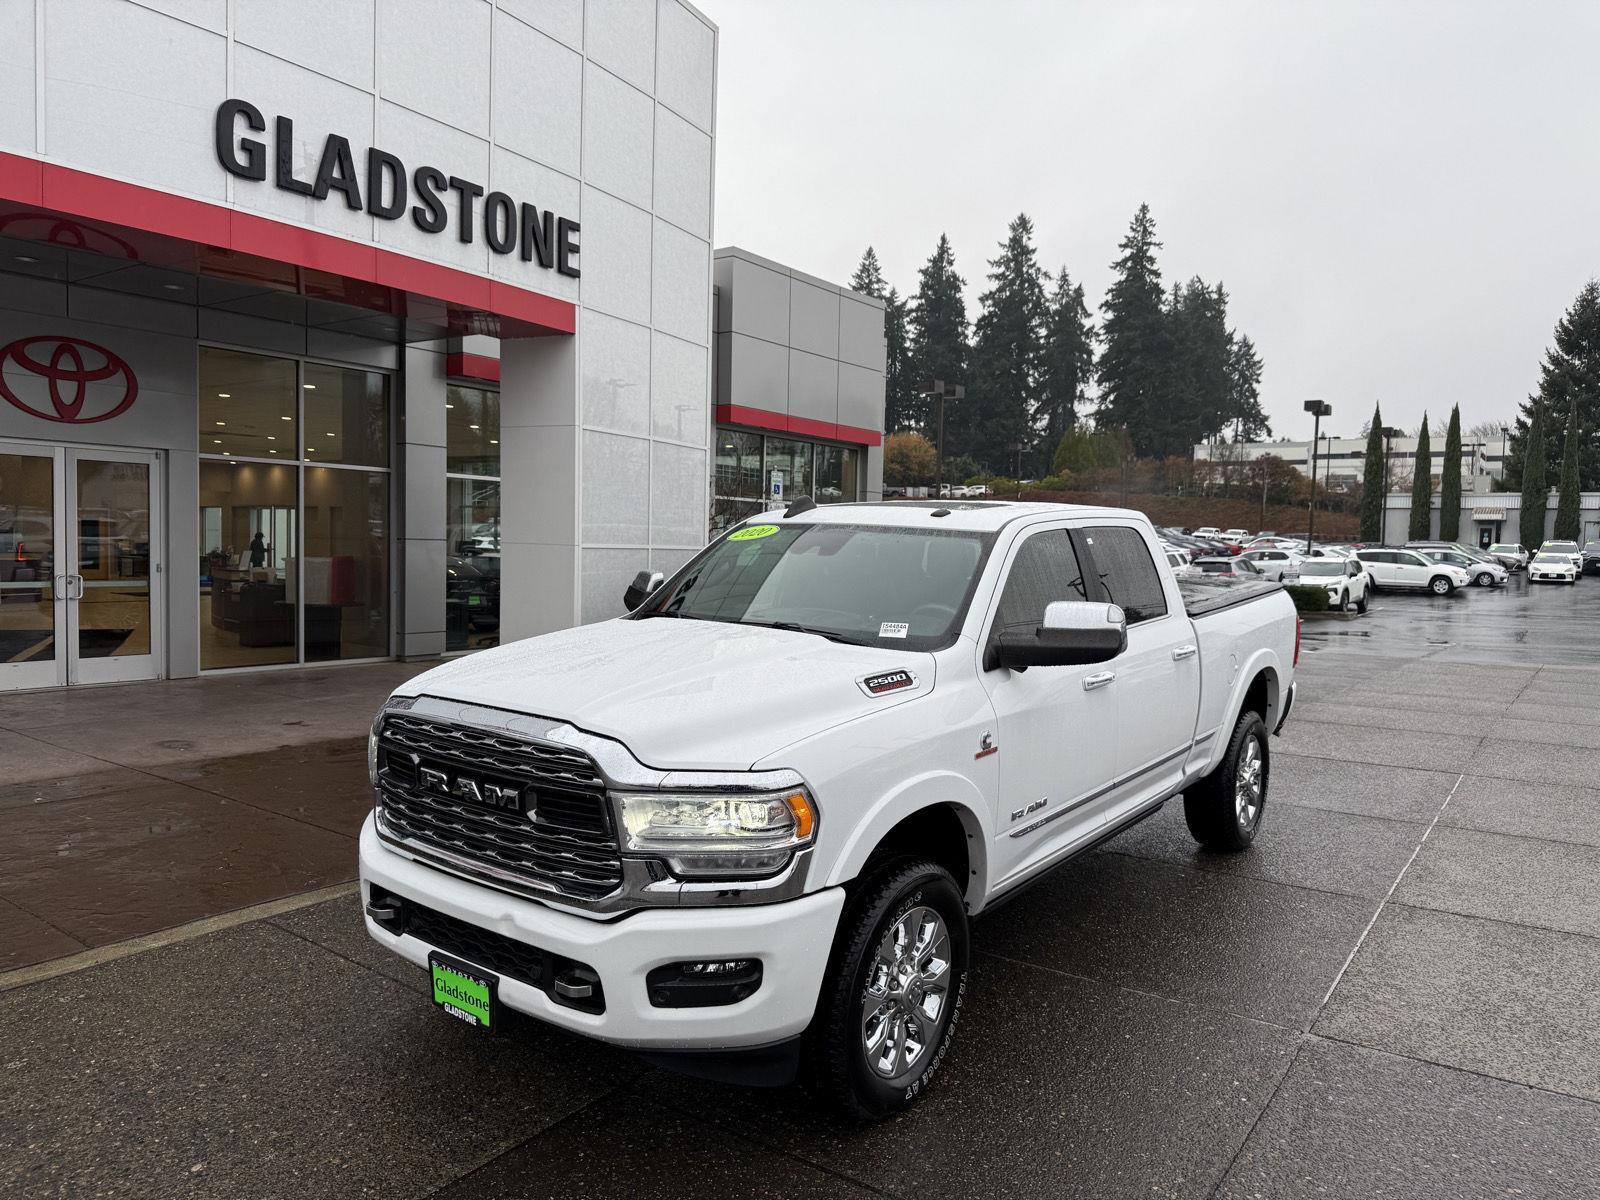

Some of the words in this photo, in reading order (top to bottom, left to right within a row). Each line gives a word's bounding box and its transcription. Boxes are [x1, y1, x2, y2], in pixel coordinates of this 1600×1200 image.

[216, 98, 581, 279] GLADSTONE
[869, 673, 907, 688] 2500
[420, 767, 520, 810] RAM
[1010, 796, 1048, 822] RAM
[435, 977, 489, 1012] Gladstone
[444, 1002, 477, 1027] GLADSTONE
